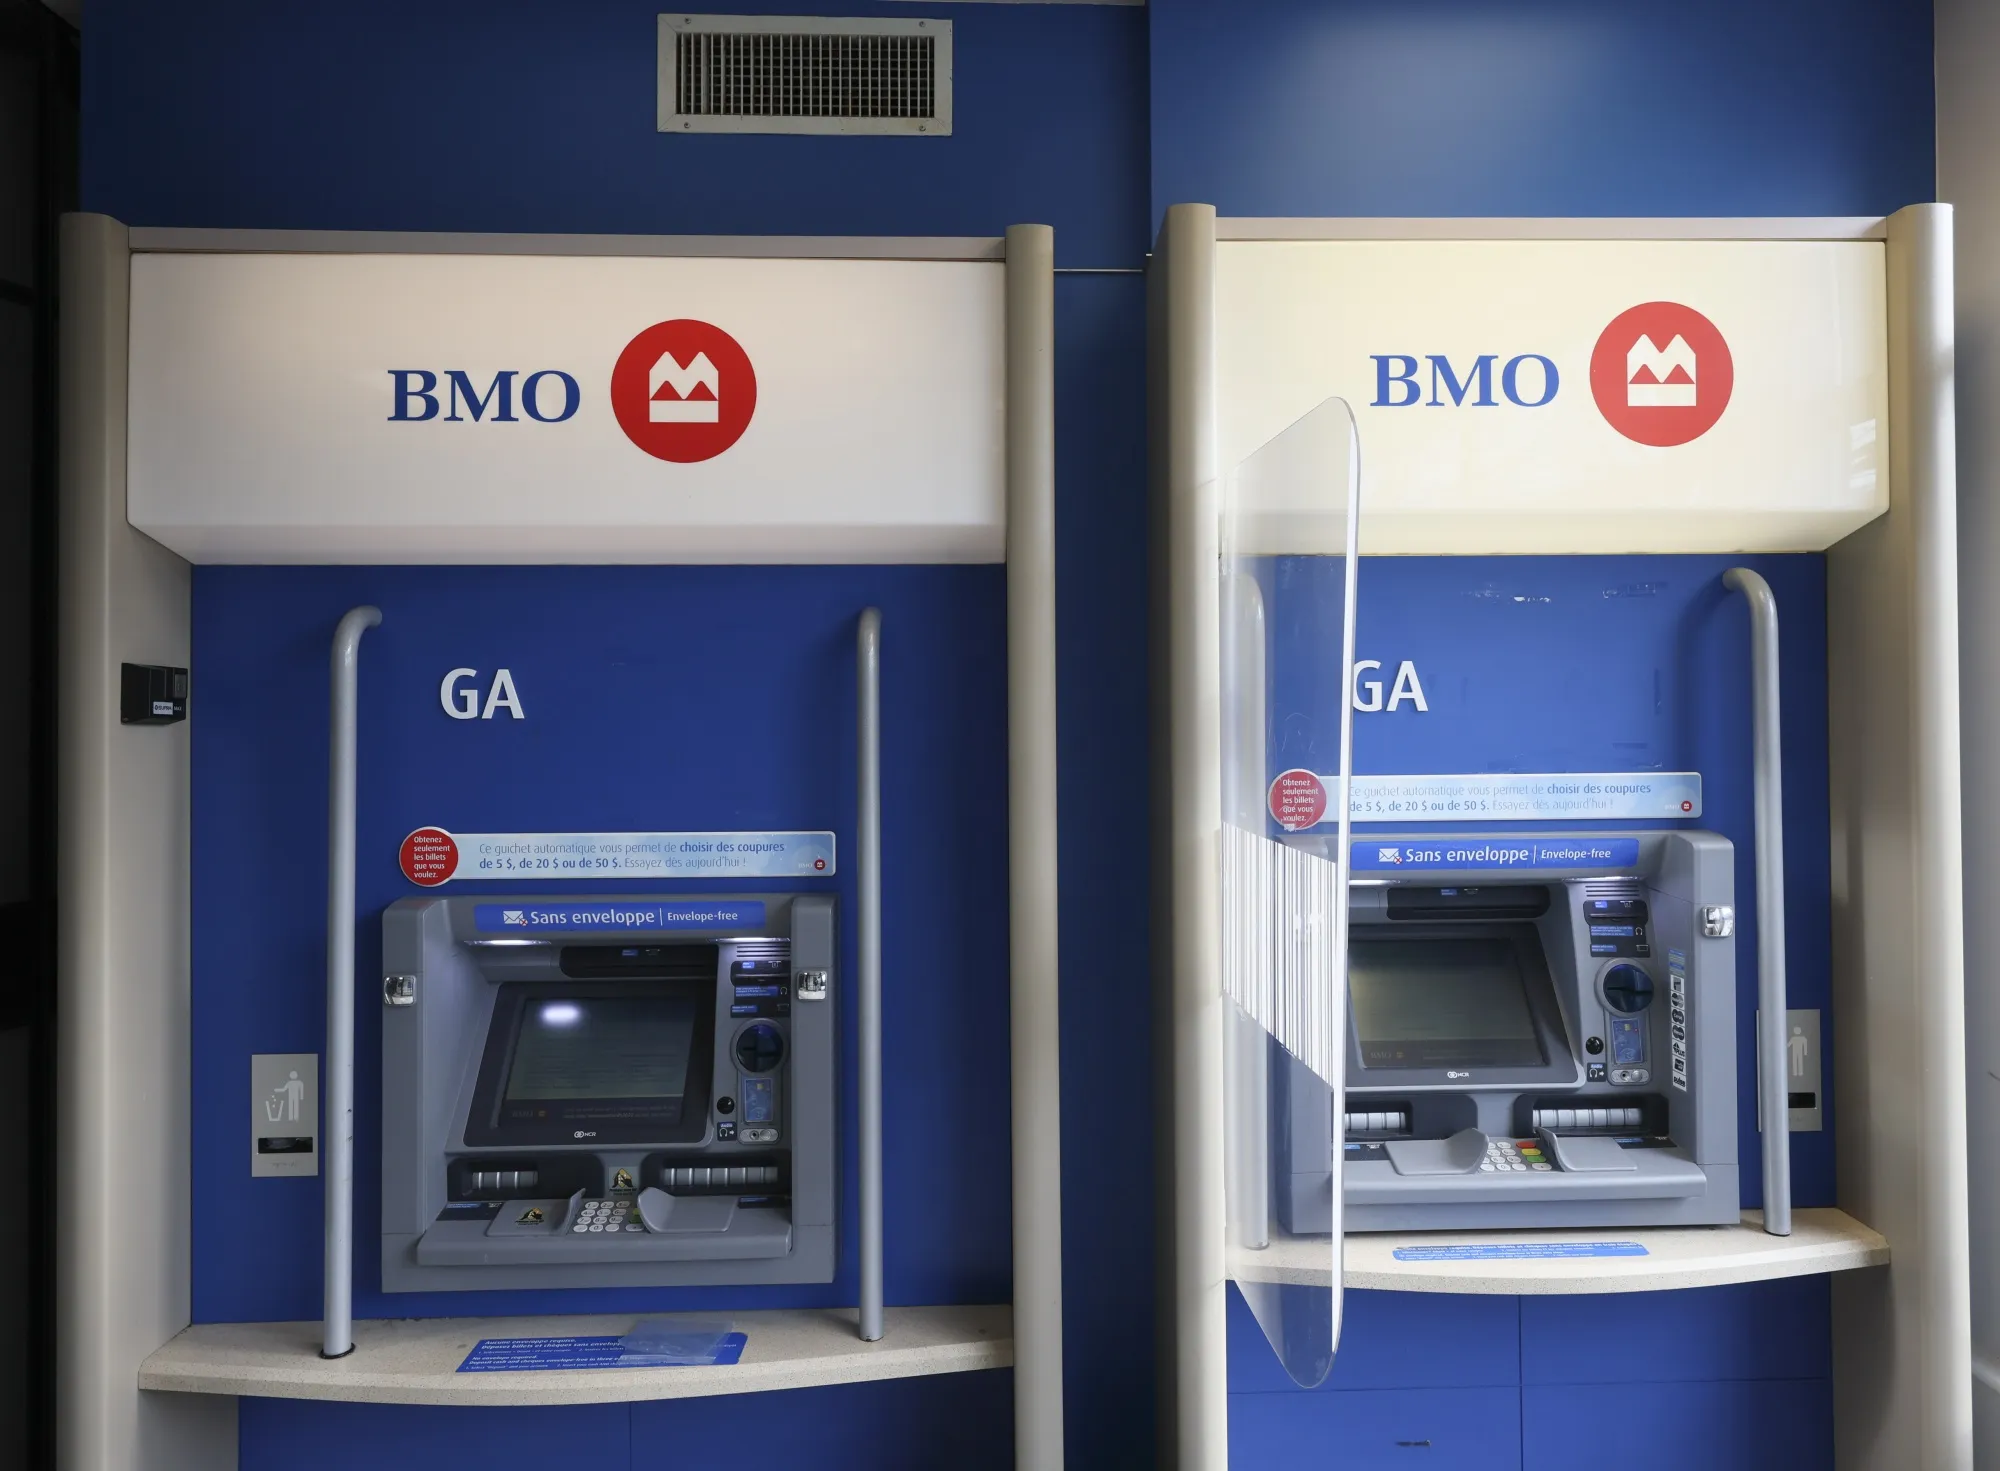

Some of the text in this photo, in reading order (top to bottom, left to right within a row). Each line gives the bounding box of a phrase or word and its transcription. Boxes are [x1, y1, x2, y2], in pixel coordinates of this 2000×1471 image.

[1370, 354, 1560, 407] BMO
[387, 370, 580, 422] BMO
[440, 668, 525, 720] GA
[1353, 660, 1428, 712] GA
[1350, 787, 1361, 796] Ce
[1364, 786, 1399, 799] guichet
[1403, 786, 1464, 798] automatique
[1493, 786, 1528, 798] permet
[1531, 784, 1544, 795] de
[1547, 784, 1580, 794] choisir
[1583, 784, 1601, 794] des
[1604, 786, 1651, 796] coupures
[1283, 806, 1296, 814] que
[1350, 802, 1362, 812] de
[1366, 802, 1372, 812] 5
[1376, 802, 1385, 814] $,
[1389, 802, 1401, 812] de
[1405, 802, 1418, 811] 20
[1421, 801, 1427, 812] $
[1448, 800, 1460, 811] de
[1464, 801, 1477, 810] 50
[1480, 800, 1489, 811] $.
[1492, 800, 1529, 812] Essayez
[1533, 798, 1549, 810] dès
[1552, 798, 1606, 812] aujourd'hui
[480, 844, 492, 854] Ce
[494, 843, 530, 856] guichet
[534, 844, 596, 855] automatique
[625, 843, 661, 855] permet
[664, 842, 677, 853] de
[680, 842, 713, 852] choisir
[717, 842, 734, 852] des
[738, 843, 784, 854] coupures
[1405, 846, 1611, 864] Sans enveloppe Envelope-free
[480, 858, 492, 868] de
[496, 859, 503, 868] 5
[506, 858, 516, 871] $,
[520, 858, 532, 868] de
[536, 858, 549, 868] 20
[552, 858, 559, 869] $
[579, 858, 592, 868] de
[596, 858, 609, 868] 50
[612, 858, 621, 869] $.
[625, 858, 662, 869] Essayez
[665, 856, 682, 867] dès
[685, 856, 740, 870] aujourd'hui
[531, 909, 738, 926] Sans enveloppe Envelope-free
